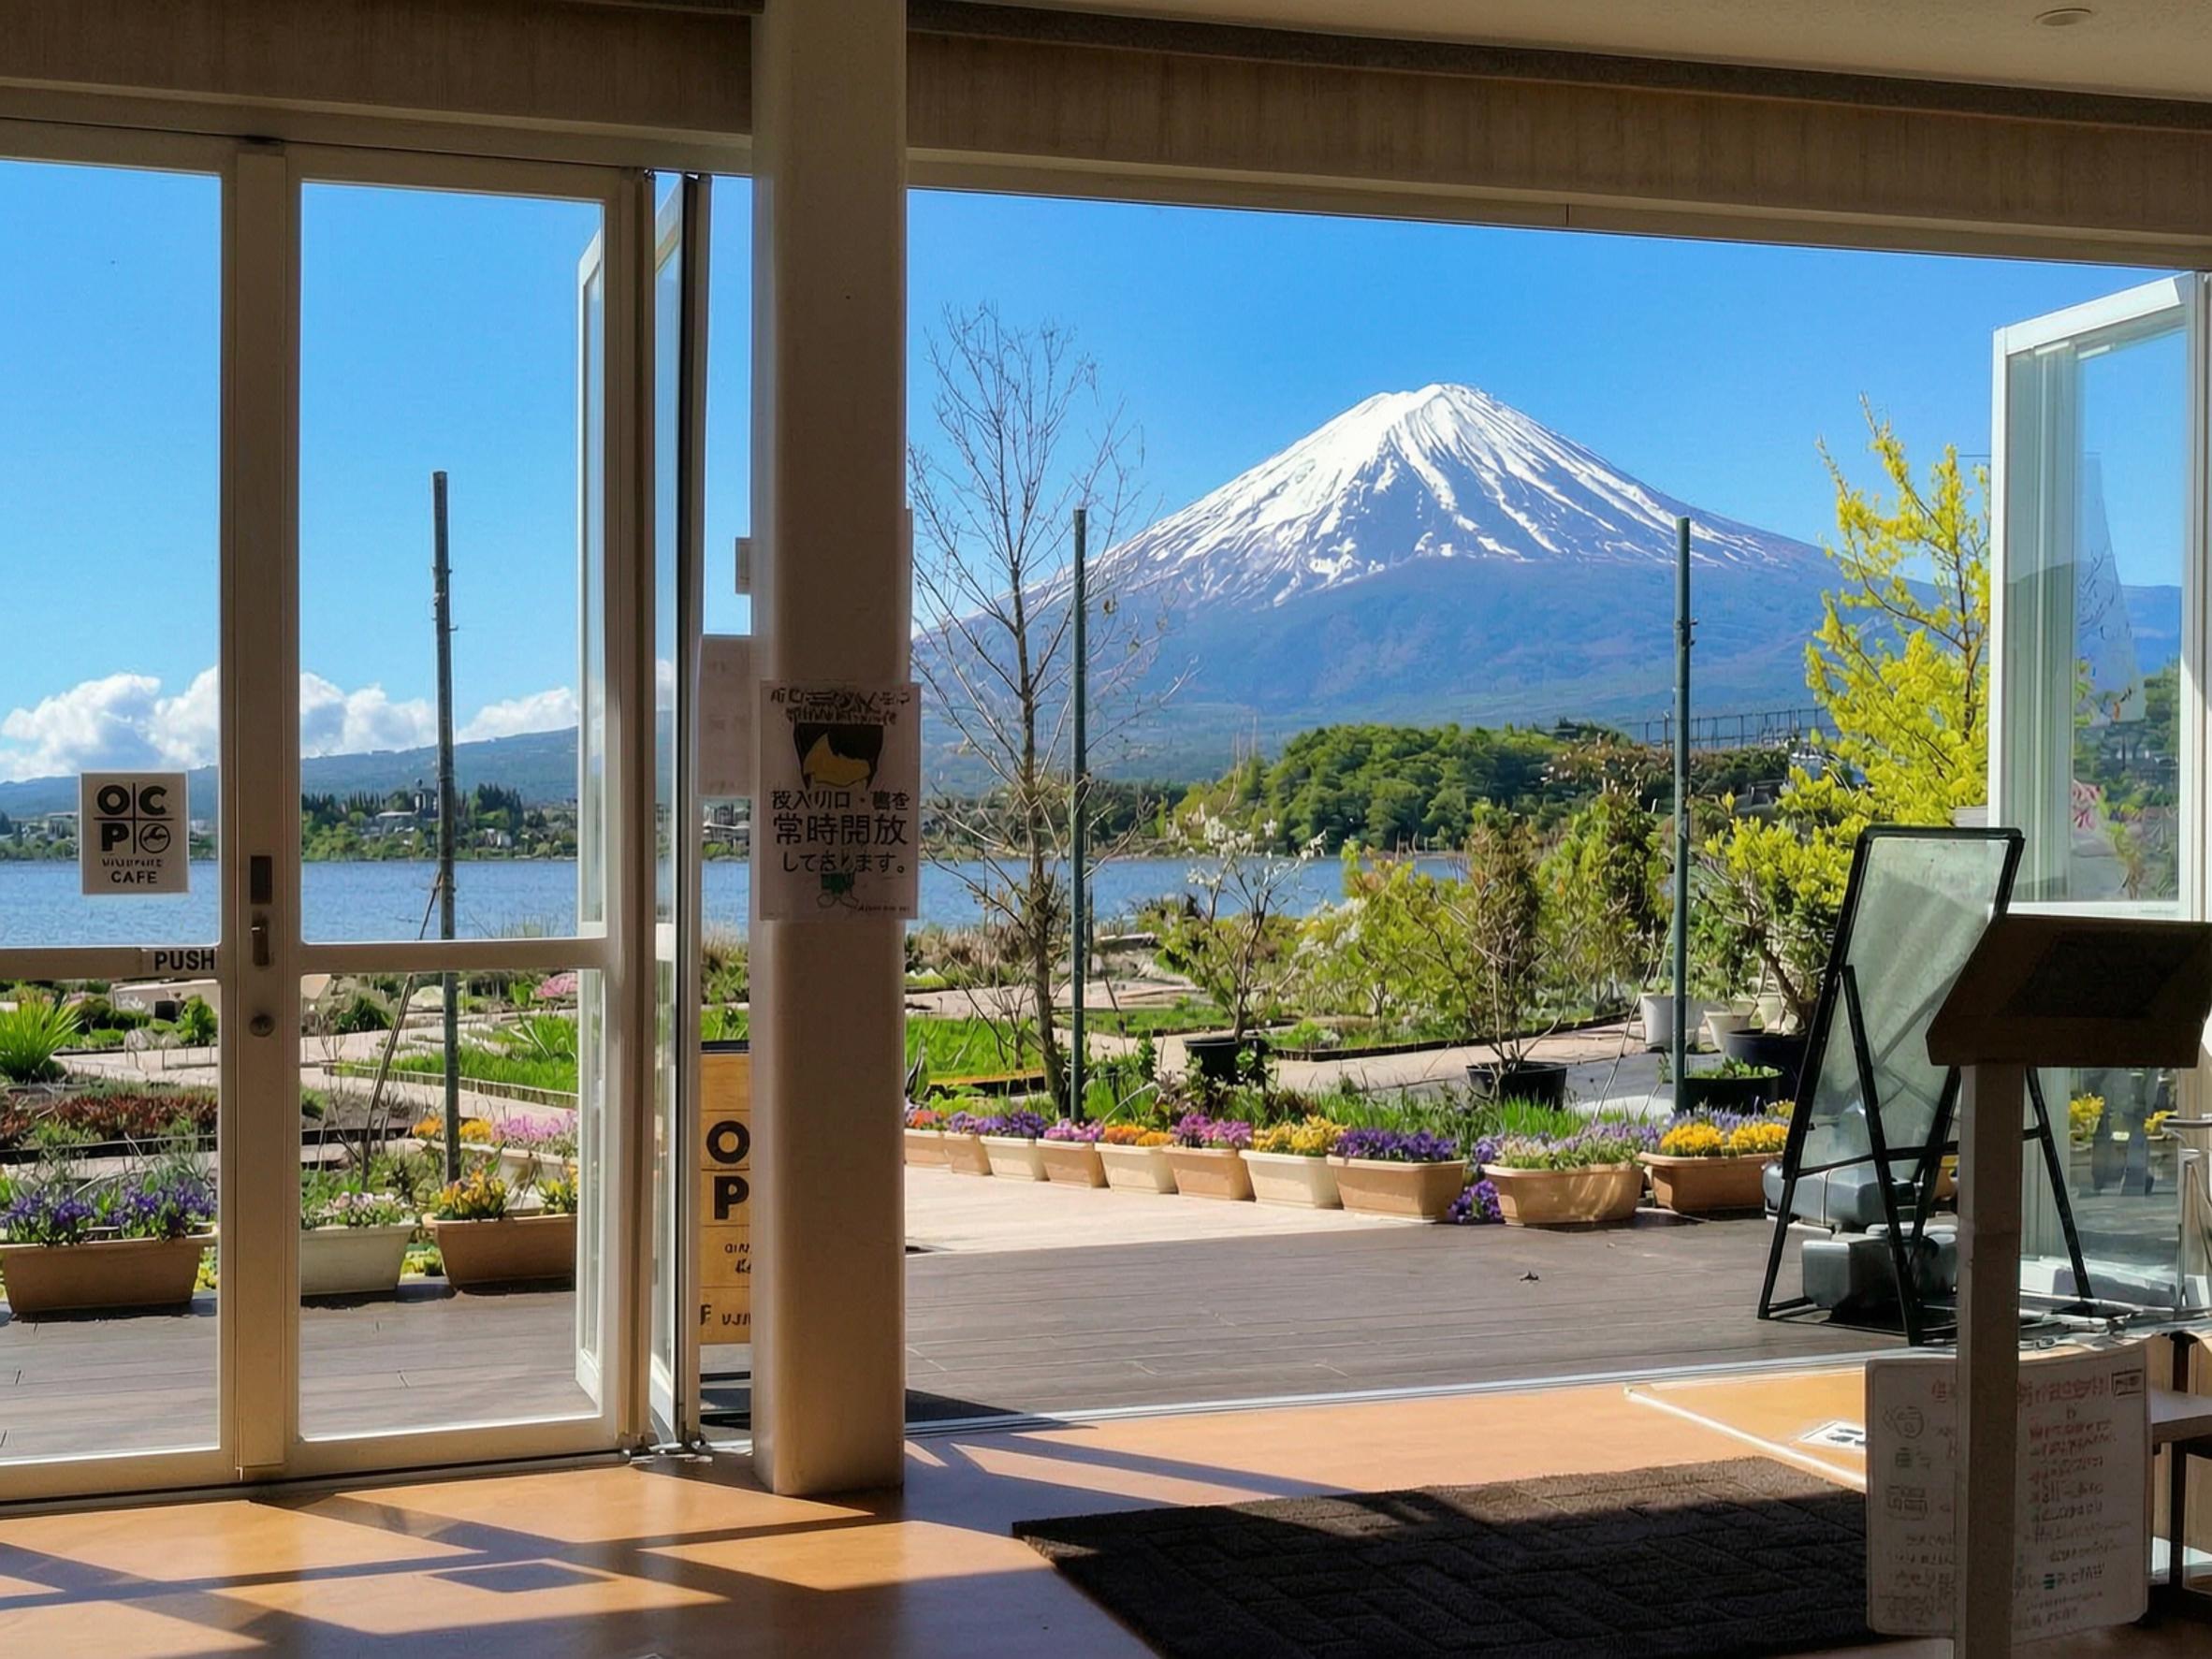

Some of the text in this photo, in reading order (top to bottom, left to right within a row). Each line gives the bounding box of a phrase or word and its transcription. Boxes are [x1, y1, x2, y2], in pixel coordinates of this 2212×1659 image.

[773, 813, 909, 846] 常時開放
[110, 870, 158, 884] CAFE
[154, 950, 215, 971] PUSH
[714, 1175, 749, 1220] P
